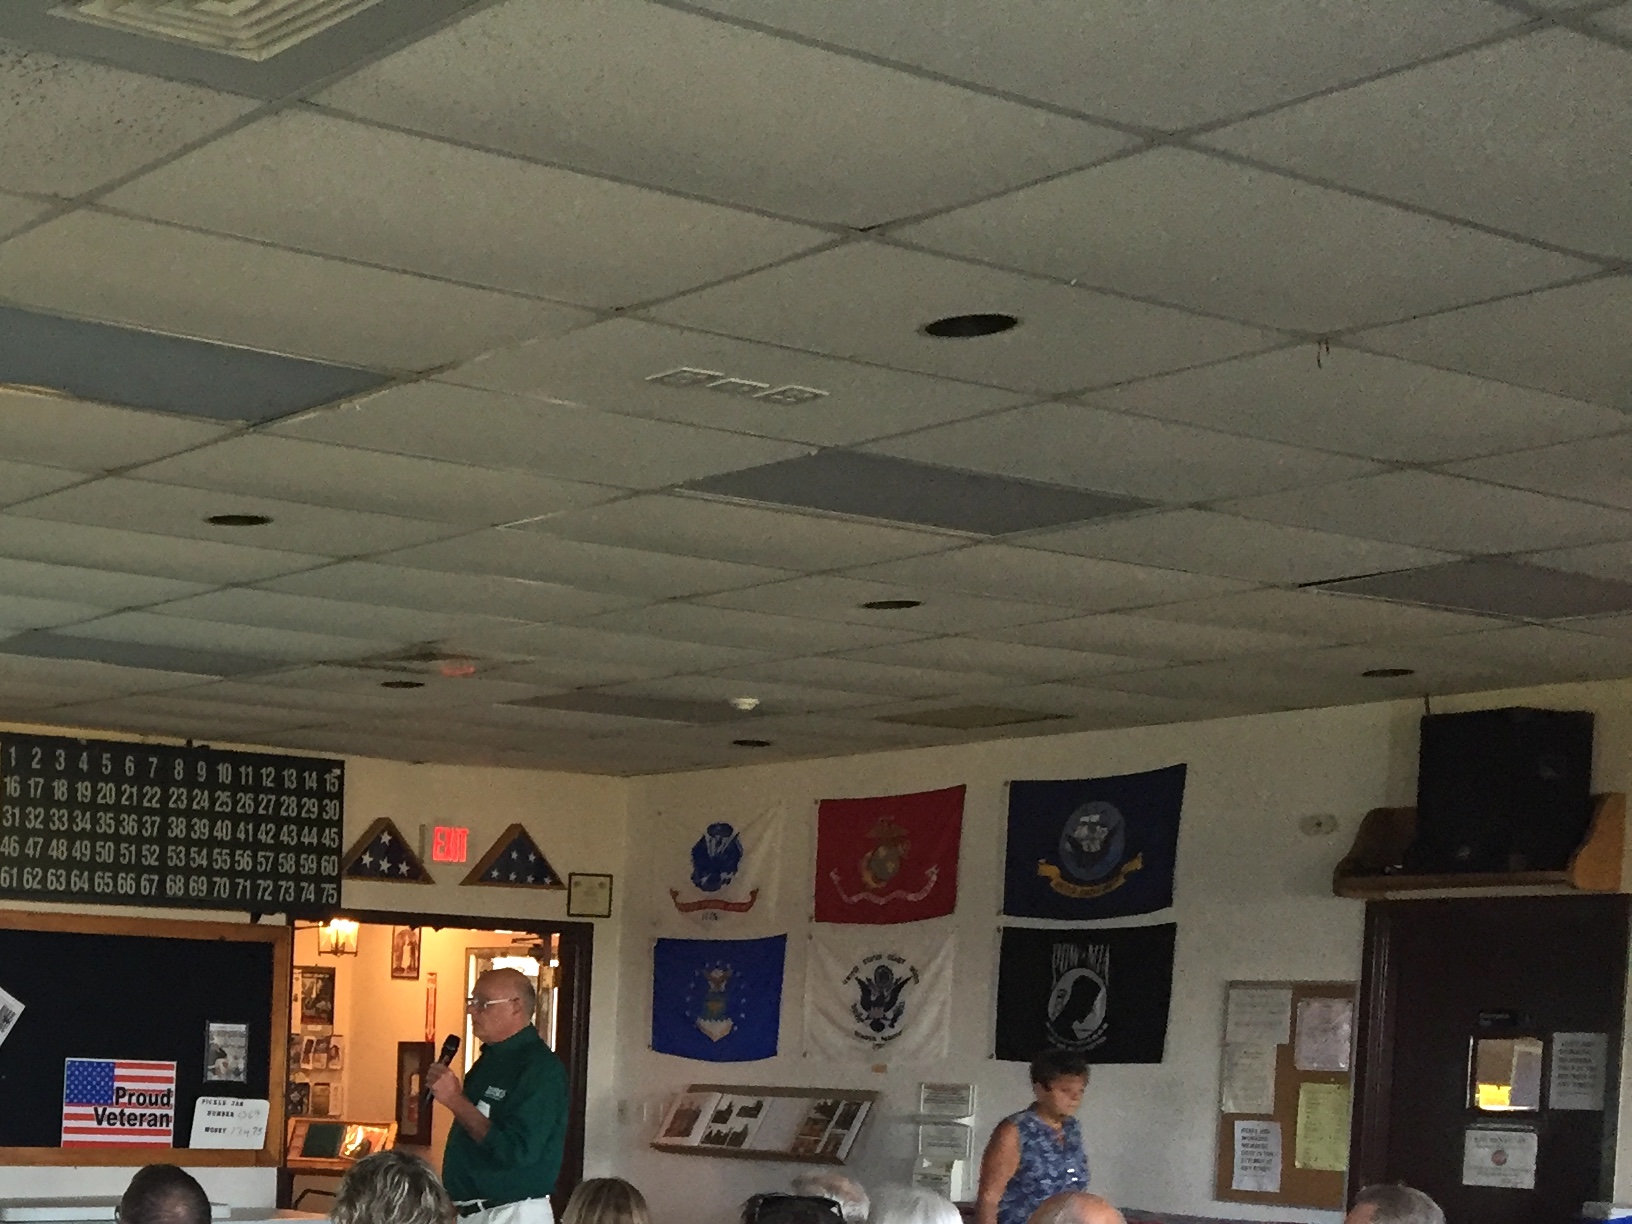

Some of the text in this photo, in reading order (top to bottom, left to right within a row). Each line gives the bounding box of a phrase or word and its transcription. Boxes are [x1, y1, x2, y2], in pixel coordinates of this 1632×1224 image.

[9, 746, 340, 792] 1 2 3 4 5 6 7 8 9 10 11 12 13 14 15
[4, 776, 339, 820] 16 17 18 19 20 21 22 23 24 25 26 27 28 29 30
[3, 805, 339, 848] 31 32 33 34 35 36 37 38 39 40 41 42 43 44 45
[432, 826, 469, 863] EXIT
[0, 836, 338, 876] 46 47 48 49 50 51 52 53 54 55 56 57 58 59 60
[0, 866, 337, 903] 61 62 63 64 65 66 67 68 69 70 71 72 73 74 75
[115, 1086, 172, 1108] Proud
[94, 1106, 170, 1128] Veteran
[204, 1126, 228, 1134] MONEY
